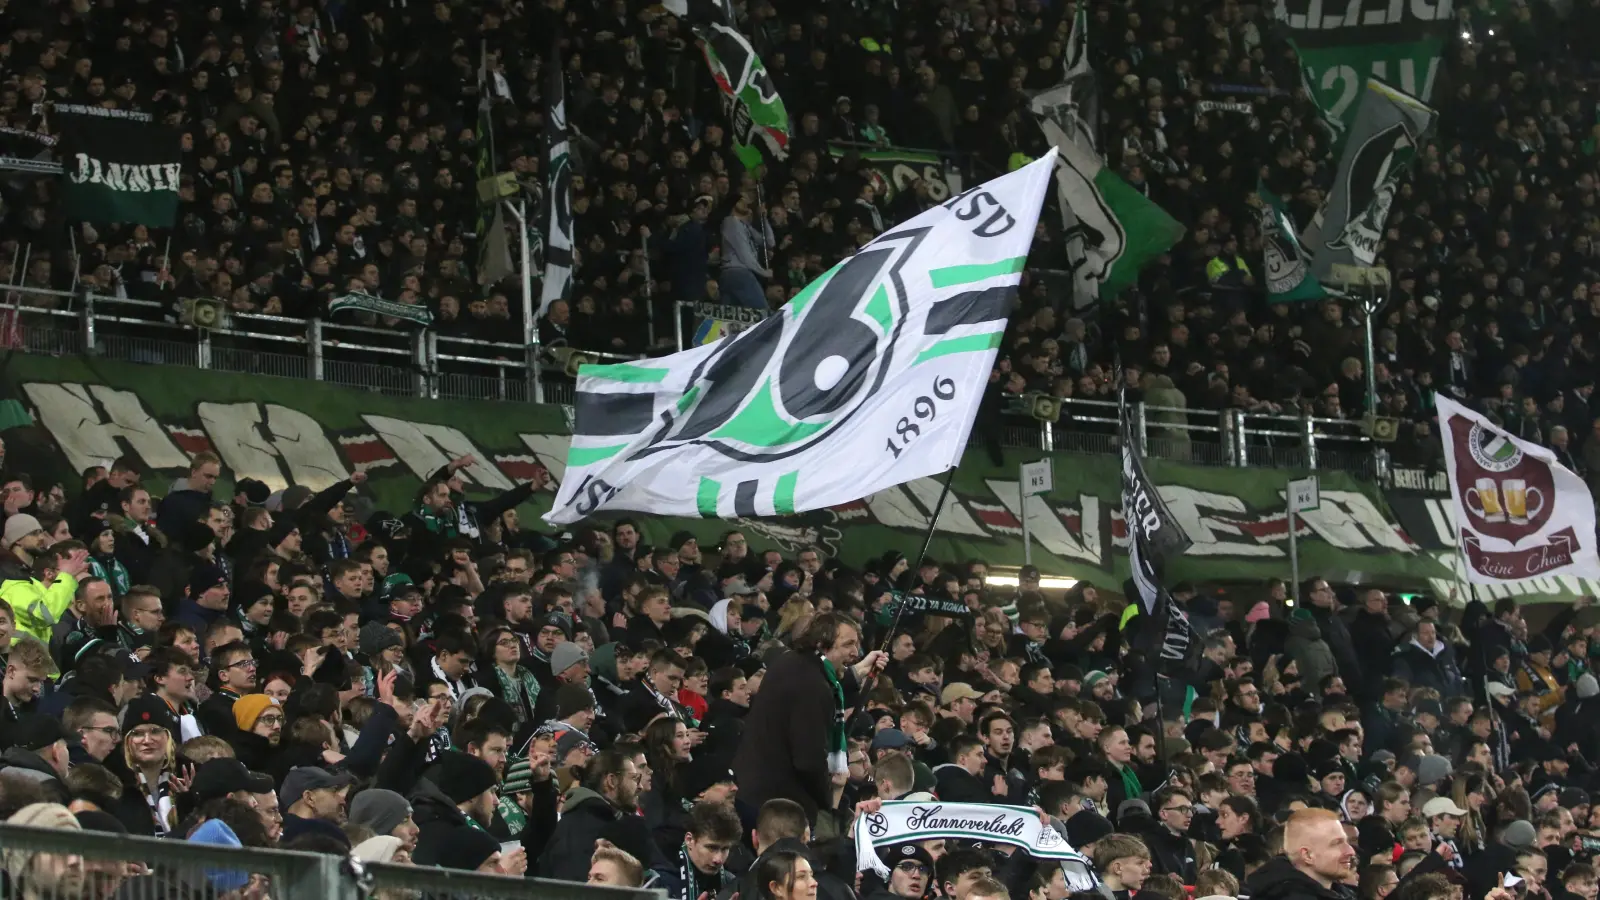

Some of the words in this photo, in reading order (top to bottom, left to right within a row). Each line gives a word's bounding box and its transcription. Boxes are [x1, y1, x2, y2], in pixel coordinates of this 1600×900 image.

[885, 374, 956, 460] 1896
[1525, 545, 1567, 574] Chaos
[906, 804, 1026, 837] Hannoverliebt
